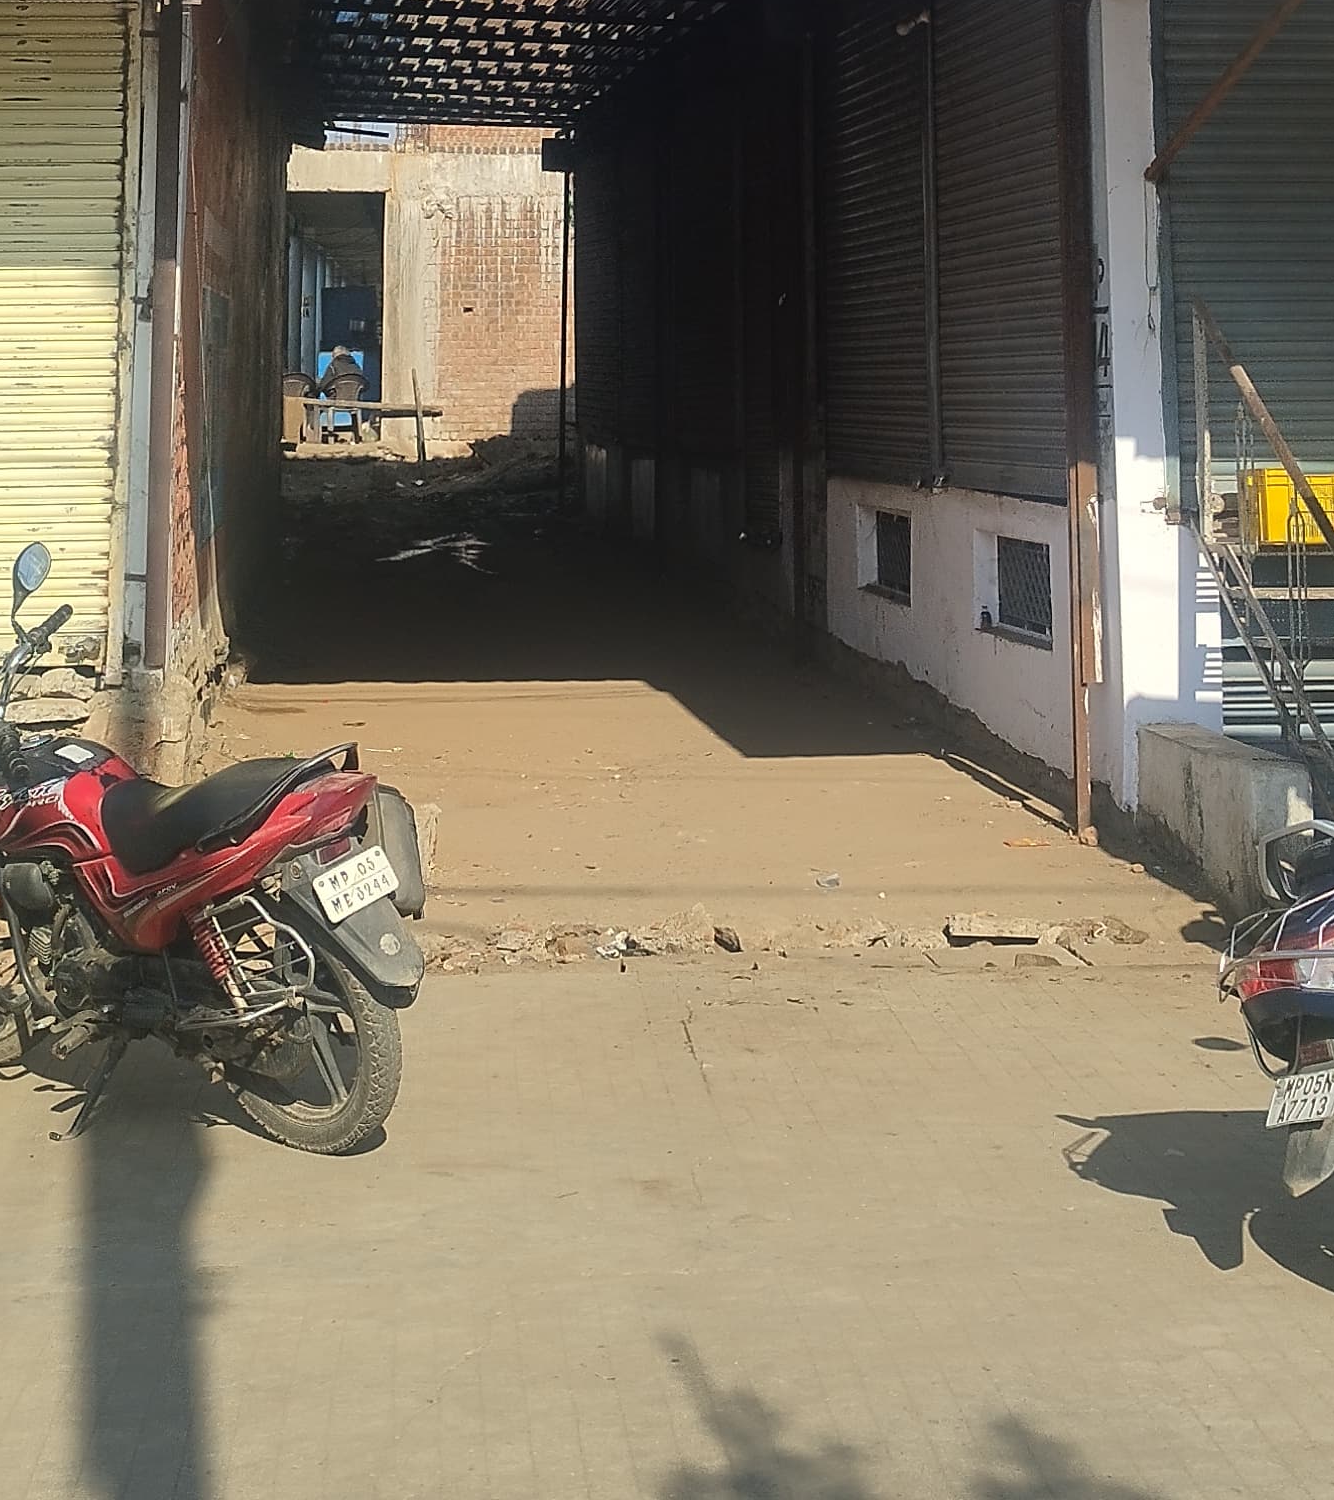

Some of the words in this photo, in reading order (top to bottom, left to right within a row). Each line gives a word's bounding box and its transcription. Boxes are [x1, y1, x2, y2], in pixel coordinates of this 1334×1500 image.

[328, 870, 349, 891] MP
[356, 857, 376, 876] 05
[1283, 1073, 1334, 1100] MP05N
[1276, 1096, 1329, 1124] A7713
